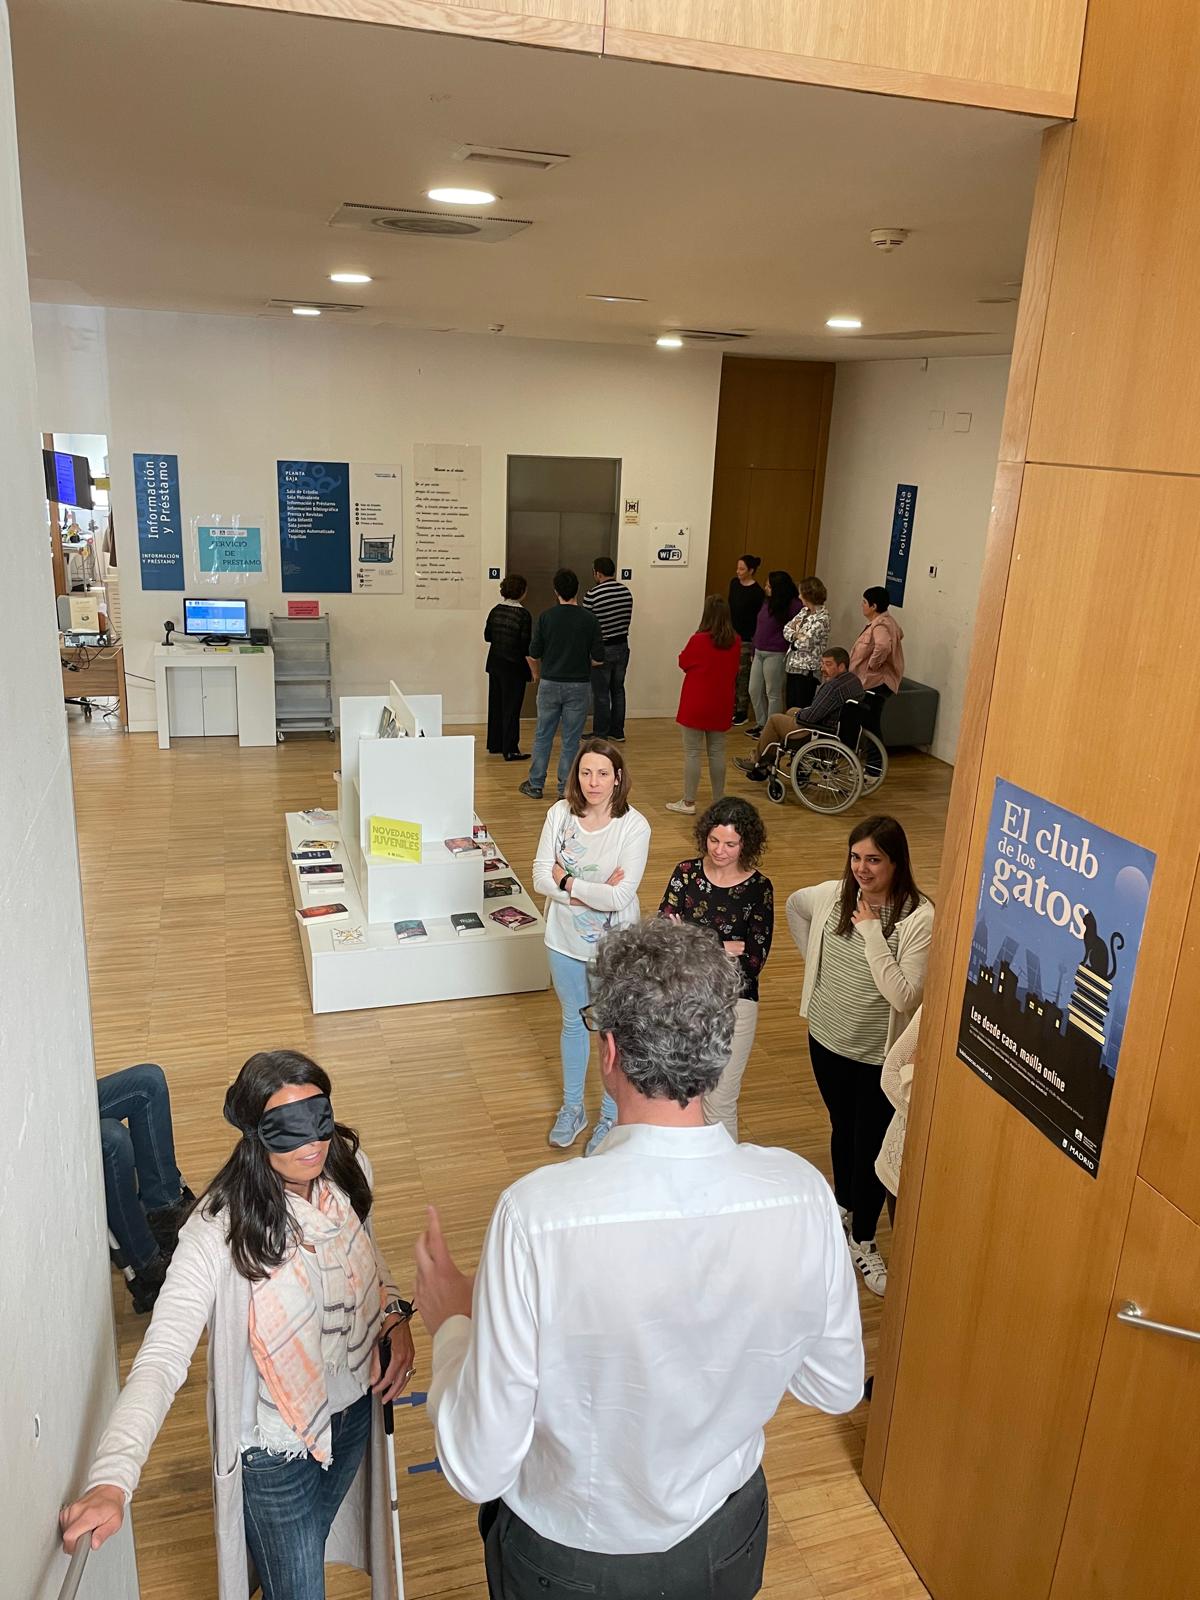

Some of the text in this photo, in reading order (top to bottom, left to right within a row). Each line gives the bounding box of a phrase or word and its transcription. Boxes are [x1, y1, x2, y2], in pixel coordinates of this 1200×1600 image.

[144, 461, 159, 539] Información
[159, 461, 171, 522] Préstamo
[898, 491, 906, 515] Sala
[898, 492, 912, 556] Polivalente
[491, 569, 498, 577] 0
[372, 825, 420, 841] NOVEDADES
[372, 835, 420, 851] JUVENILES
[997, 837, 1036, 870] de los
[1000, 800, 1099, 879] El club
[989, 858, 1089, 940] gatos
[971, 1005, 1066, 1092] Lee desde casa, maúlla online
[1069, 1144, 1095, 1170] MADRID
